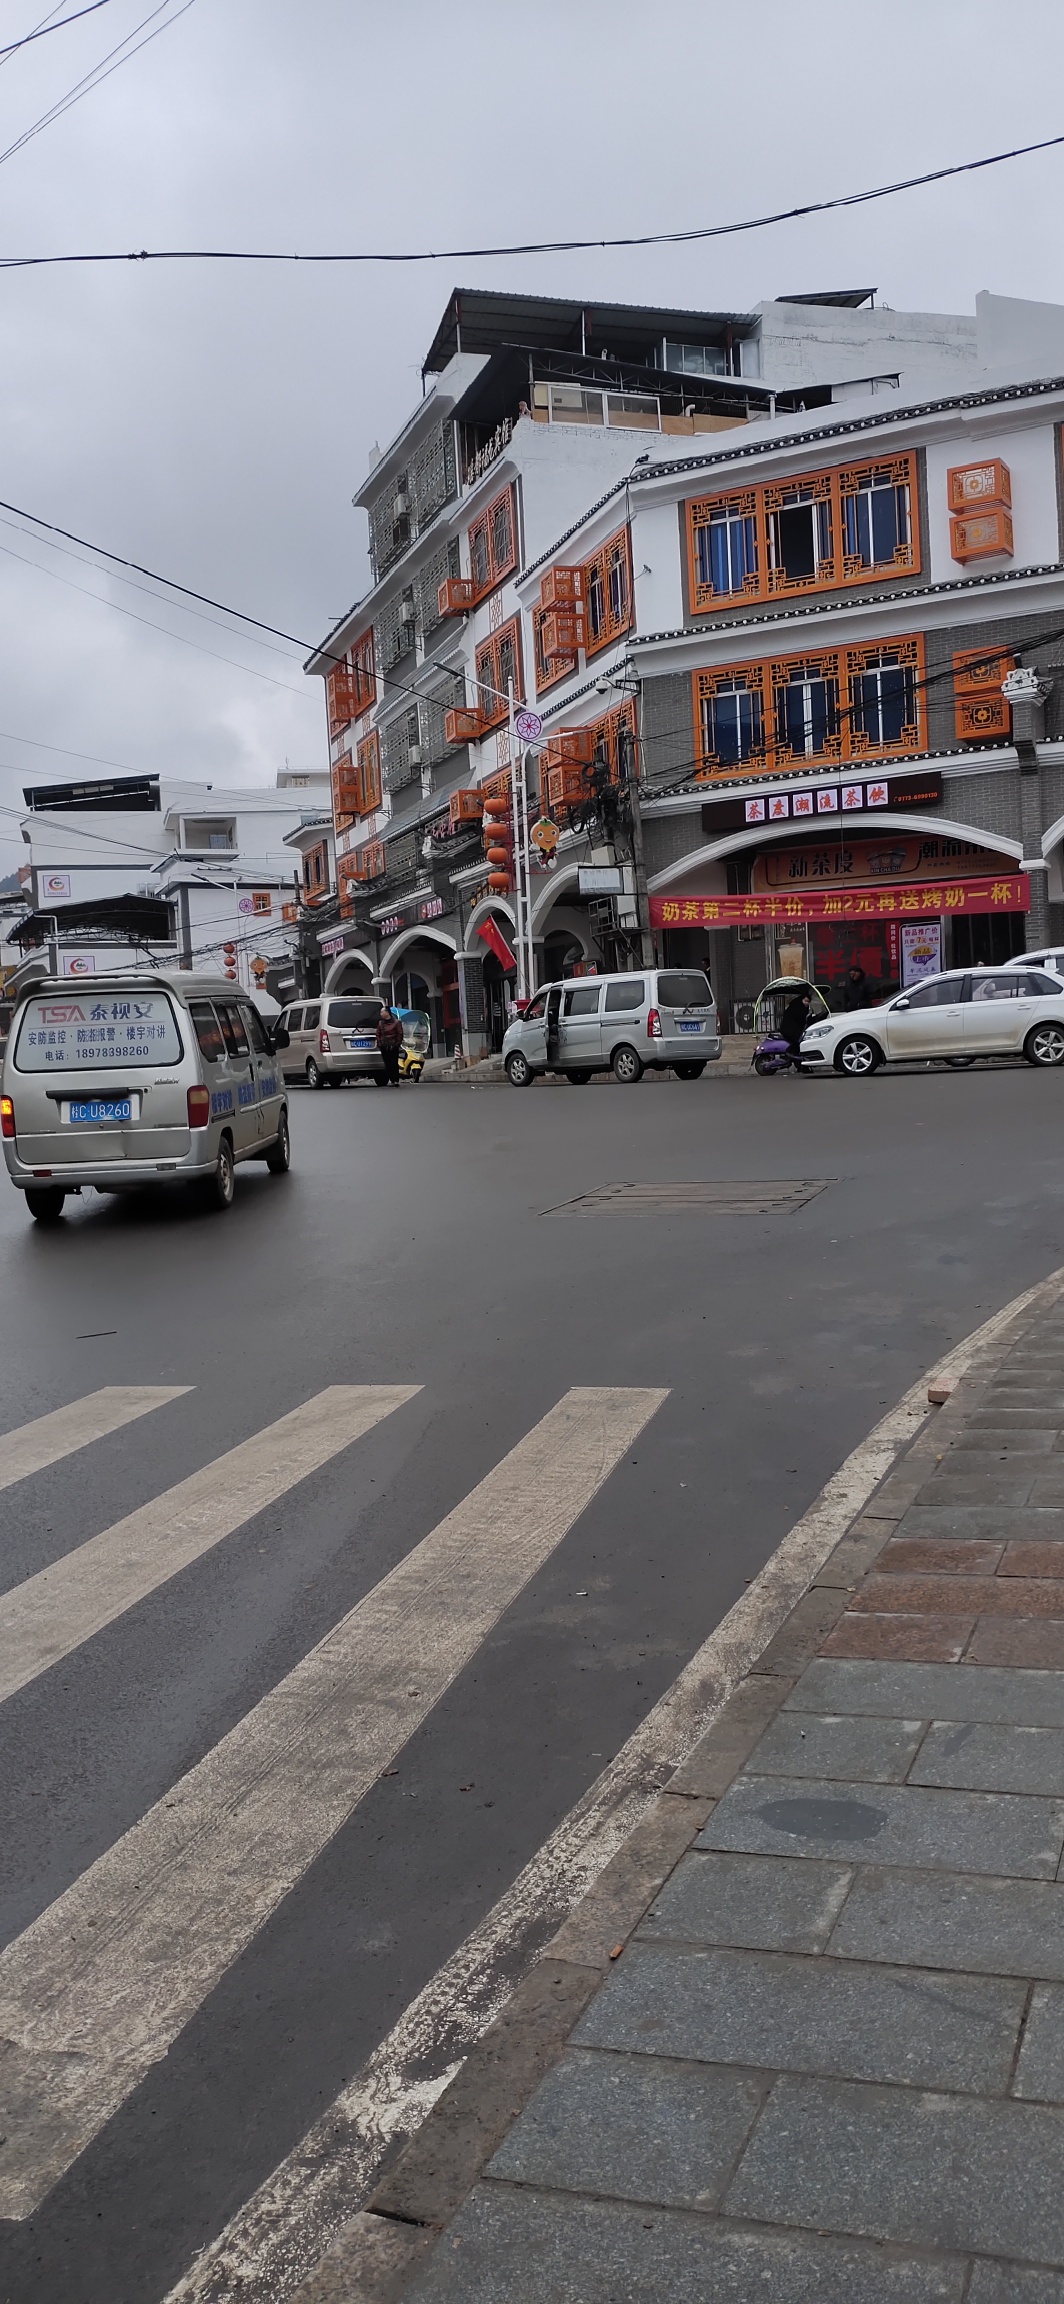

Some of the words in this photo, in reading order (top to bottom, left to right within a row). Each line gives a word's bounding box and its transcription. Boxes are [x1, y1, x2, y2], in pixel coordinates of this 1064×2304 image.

[746, 783, 888, 822] 茶度潮流茶饮
[788, 850, 854, 878] 新茶度
[38, 1004, 86, 1024] TSA
[90, 1001, 154, 1022] 泰视安
